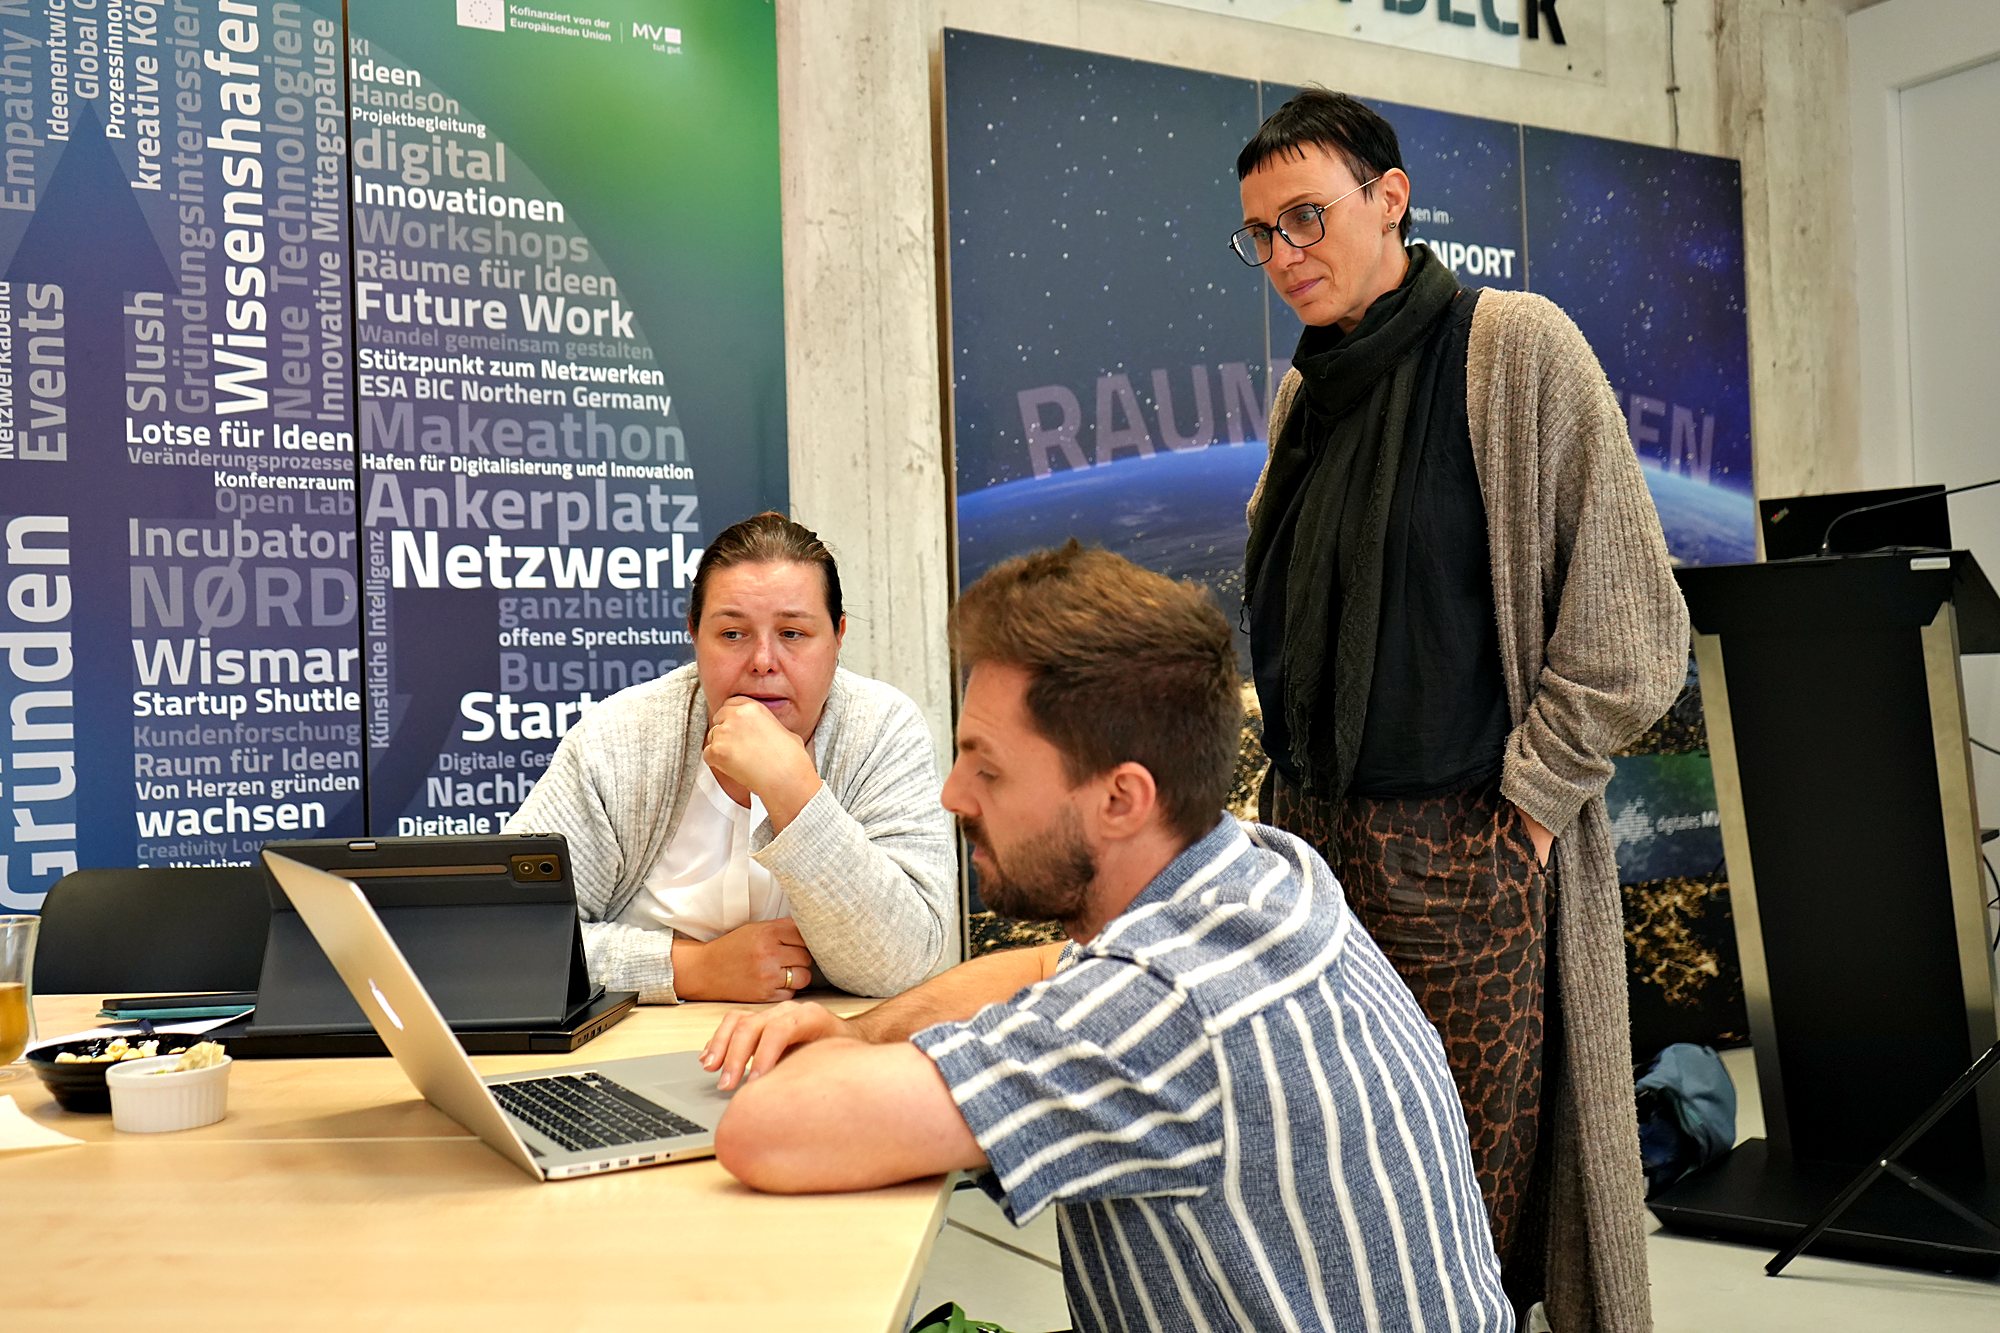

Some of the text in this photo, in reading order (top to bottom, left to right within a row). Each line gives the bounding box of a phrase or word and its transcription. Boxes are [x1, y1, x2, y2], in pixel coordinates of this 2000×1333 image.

[509, 4, 610, 29] Kofinanziert von der
[510, 17, 611, 41] Europäischen Union
[632, 22, 662, 41] MV
[73, 17, 99, 99] Global
[351, 37, 369, 56] KI
[351, 58, 421, 87] Ideen
[351, 83, 459, 115] HandsOn
[0, 28, 44, 211] Empathy
[129, 56, 161, 190] kreative
[352, 106, 486, 138] Projektbegleitung
[354, 128, 506, 187] digital
[263, 2, 314, 419] Neue Technologien
[354, 175, 565, 223] Innovationen
[1433, 206, 1449, 224] im
[311, 19, 346, 421] Innovative Mittagspause
[356, 207, 589, 269] Workshops
[356, 249, 617, 298] Räume für Ideen
[1404, 237, 1516, 278] NPORT
[356, 281, 635, 339] Future Work
[124, 291, 167, 412] Slush
[360, 324, 653, 361] Wandel gemeinsam gestalten
[18, 283, 67, 461] Events
[359, 348, 664, 385] Stützpunkt zum Netzwerken
[359, 375, 671, 416] ESA BIC Northern Germany
[126, 417, 353, 451] Lotse für Ideen
[361, 400, 685, 461] Makeathon
[1616, 391, 1715, 485] EN
[128, 447, 353, 472] Veränderungsprozesse
[361, 453, 693, 480] Hafen für Digitalisierung und Innovation
[214, 471, 355, 491] Konferenzraum
[216, 487, 354, 518] Open Lab
[364, 473, 699, 545] Ankerplatz
[129, 518, 355, 559] Incubator
[390, 530, 705, 589] Netzwerk
[130, 556, 357, 635] NØRD
[368, 530, 390, 748] Künstliche Intelligenz
[499, 627, 566, 647] offene
[132, 637, 358, 686] Wismar
[133, 687, 360, 720] Startup Shuttle
[134, 721, 360, 747] Kundenforschung
[134, 748, 359, 777] Raum für Ideen
[439, 751, 515, 775] Digitale
[136, 774, 359, 800] Von Herzen gründen
[136, 798, 325, 838] wachsen
[398, 813, 490, 837] Digitale
[137, 839, 226, 859] Creativity
